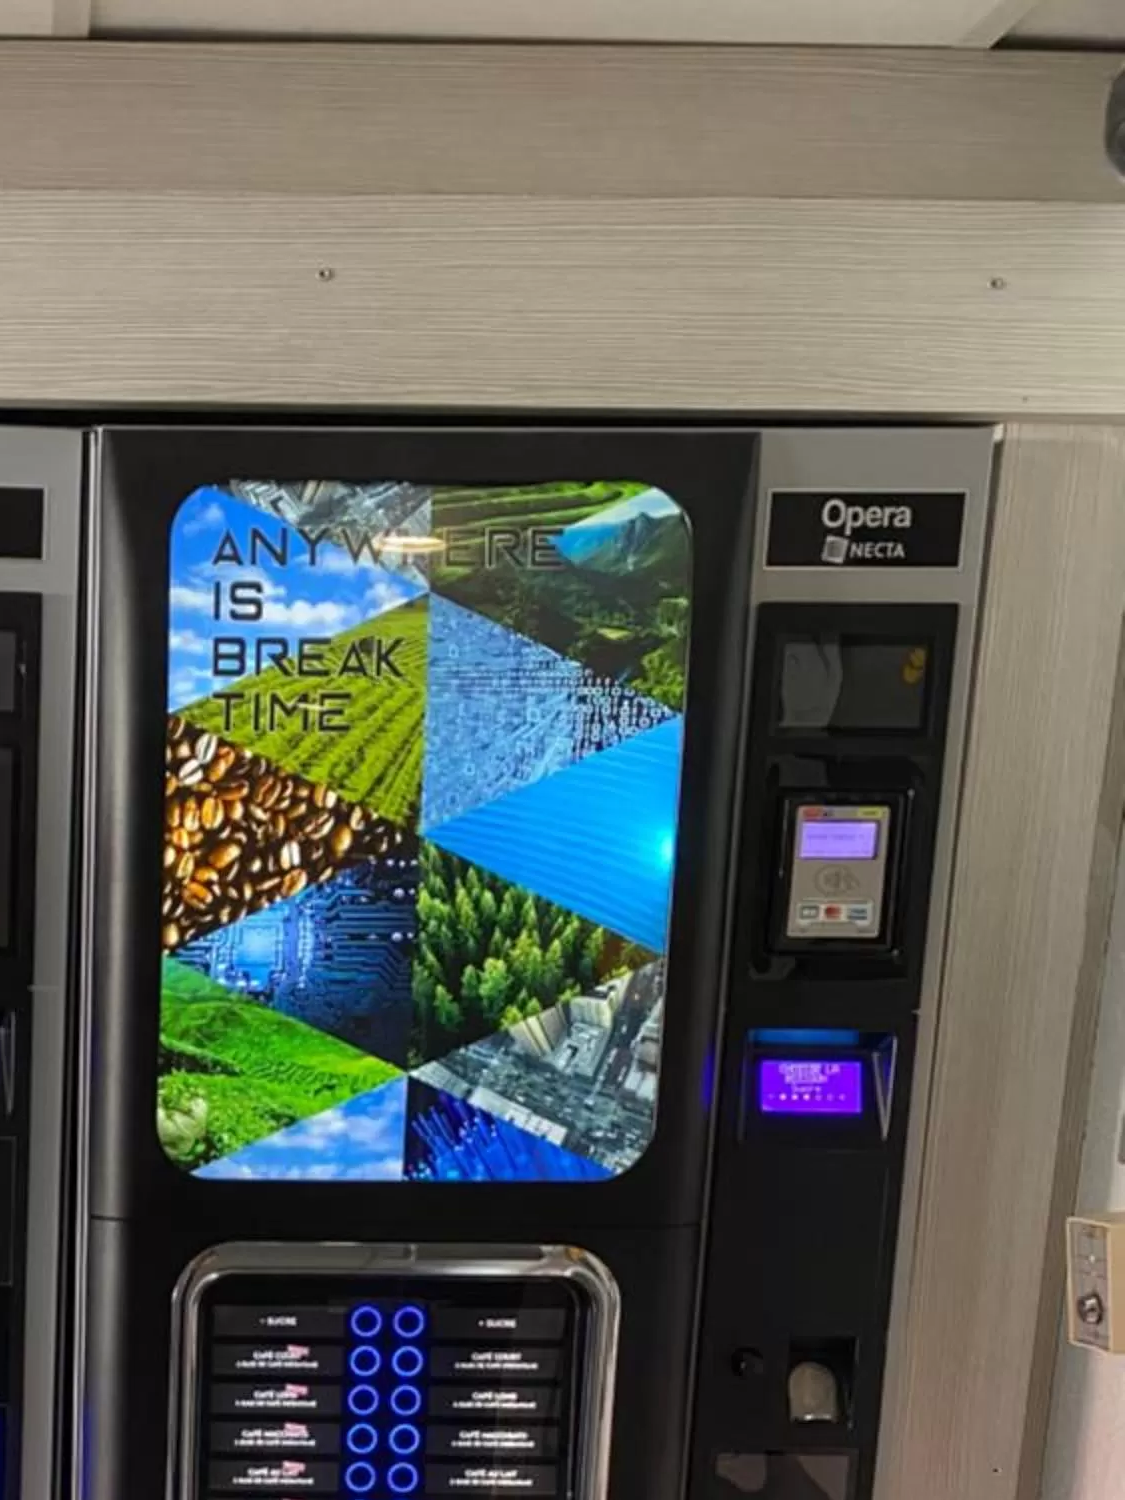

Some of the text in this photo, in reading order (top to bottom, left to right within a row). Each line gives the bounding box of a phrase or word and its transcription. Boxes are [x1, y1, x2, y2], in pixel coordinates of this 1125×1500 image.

[821, 499, 912, 536] Opera
[211, 526, 567, 570] ANYWHERE
[849, 541, 906, 558] NECTA
[212, 581, 264, 622] IS
[211, 636, 407, 679] BREAK
[210, 692, 353, 734] TIME
